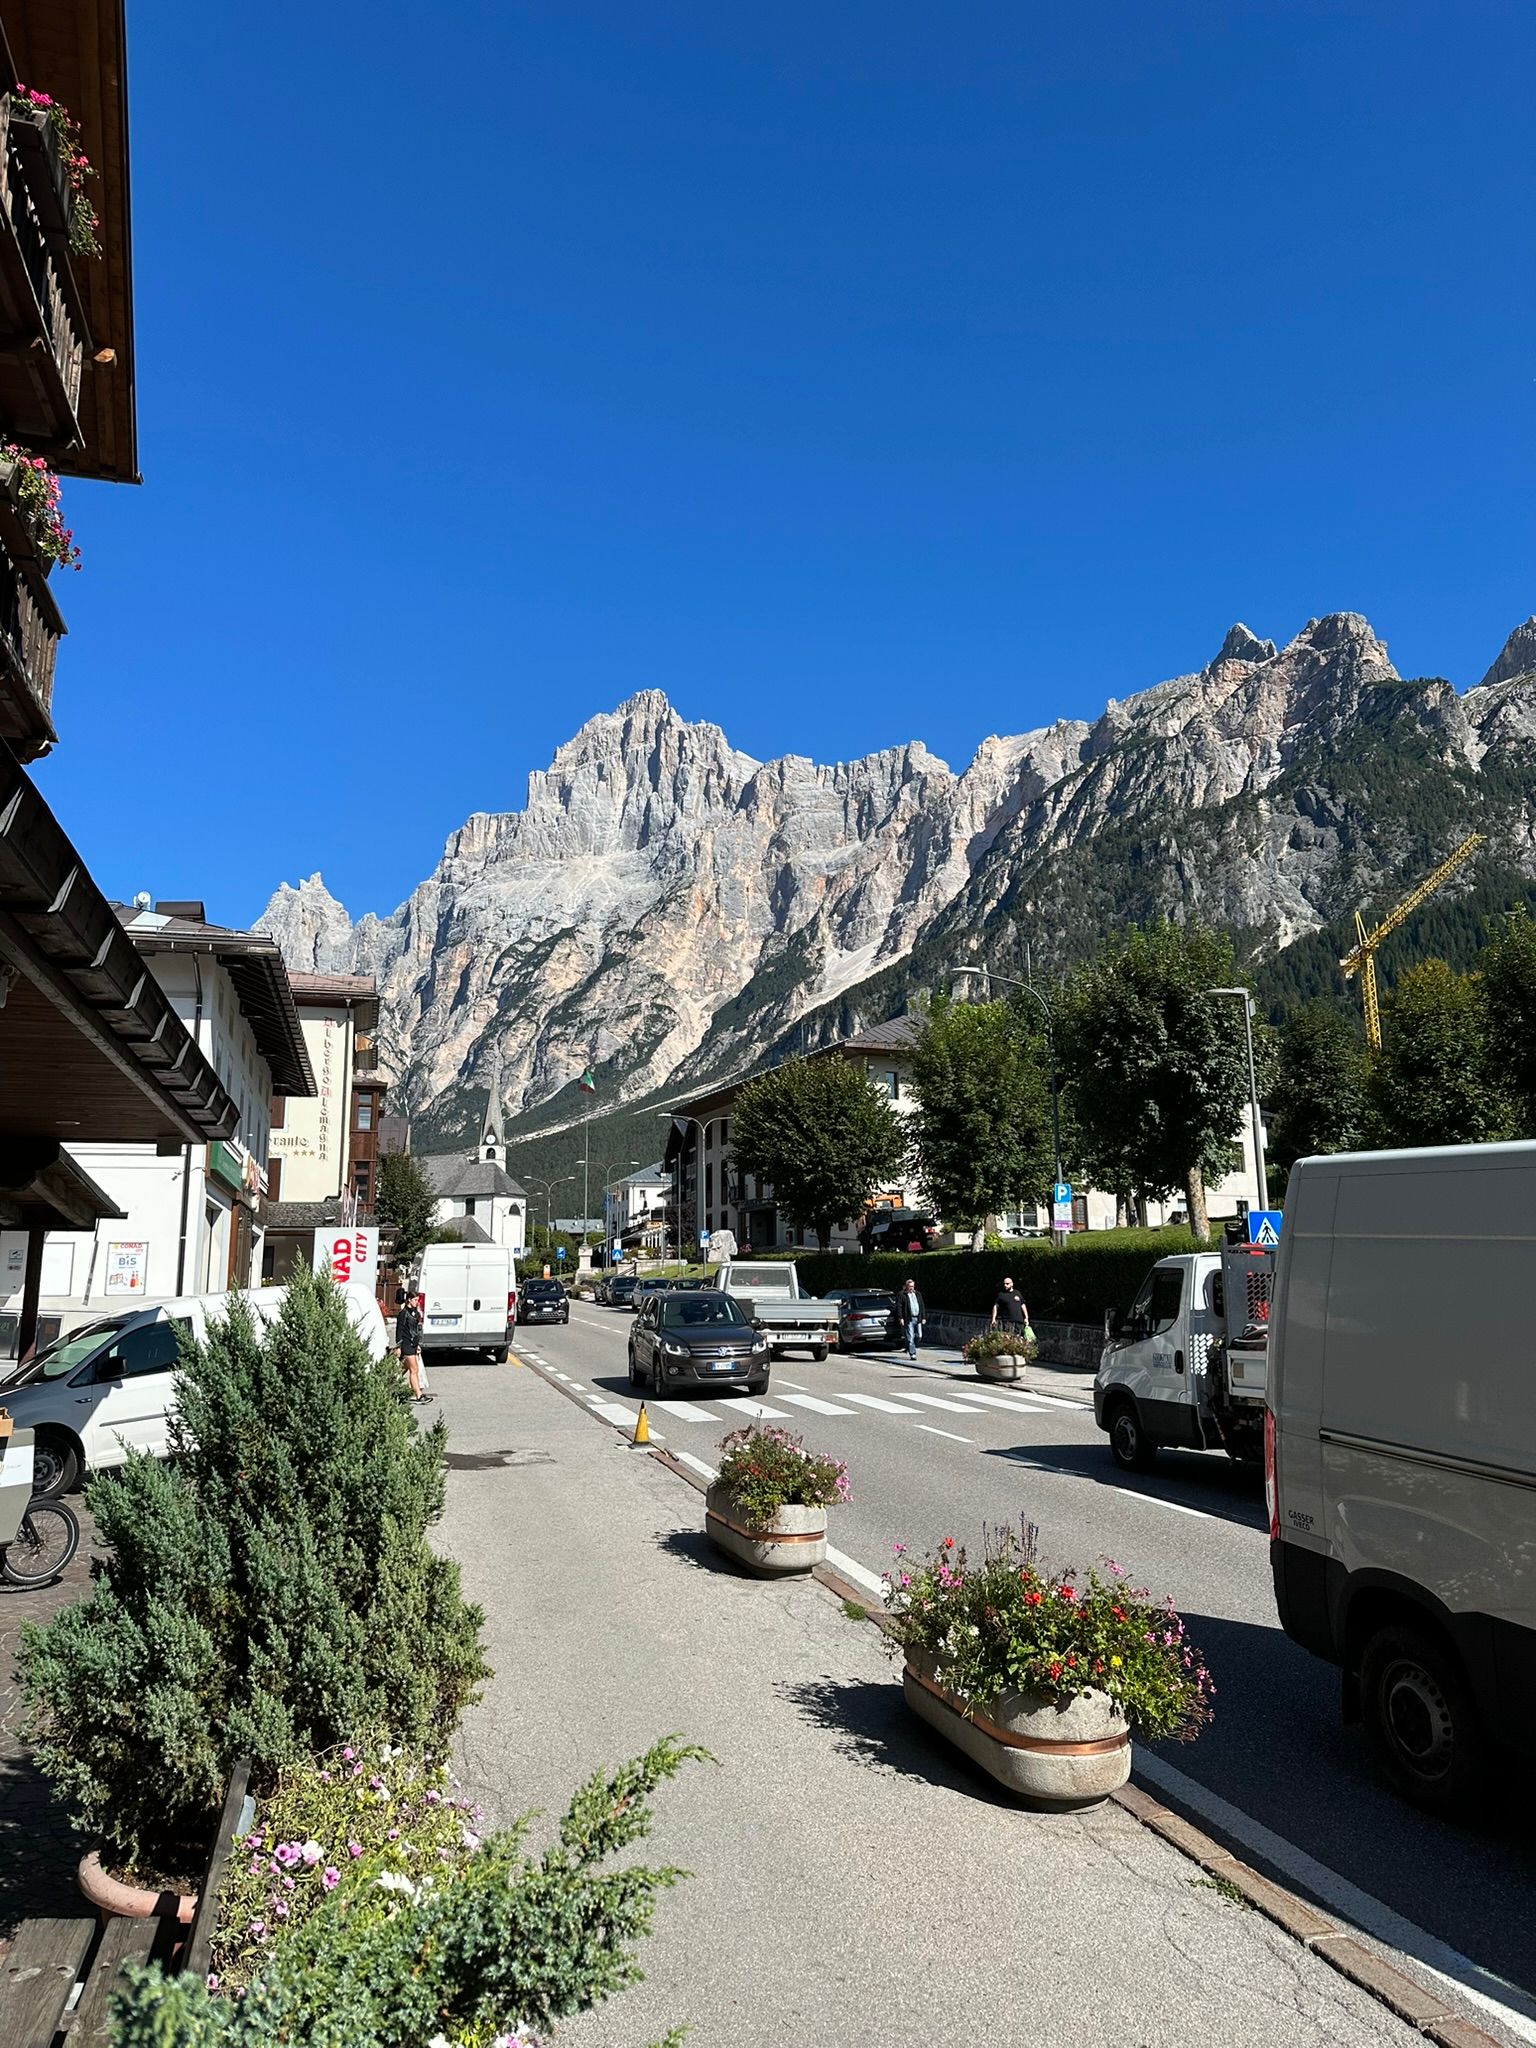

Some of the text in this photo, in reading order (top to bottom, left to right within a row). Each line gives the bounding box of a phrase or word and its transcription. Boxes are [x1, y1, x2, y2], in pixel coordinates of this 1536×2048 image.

[1058, 1186, 1068, 1201] P
[355, 1232, 368, 1263] CITY
[1288, 1510, 1315, 1525] GASSER
[1293, 1520, 1311, 1531] IVECO
